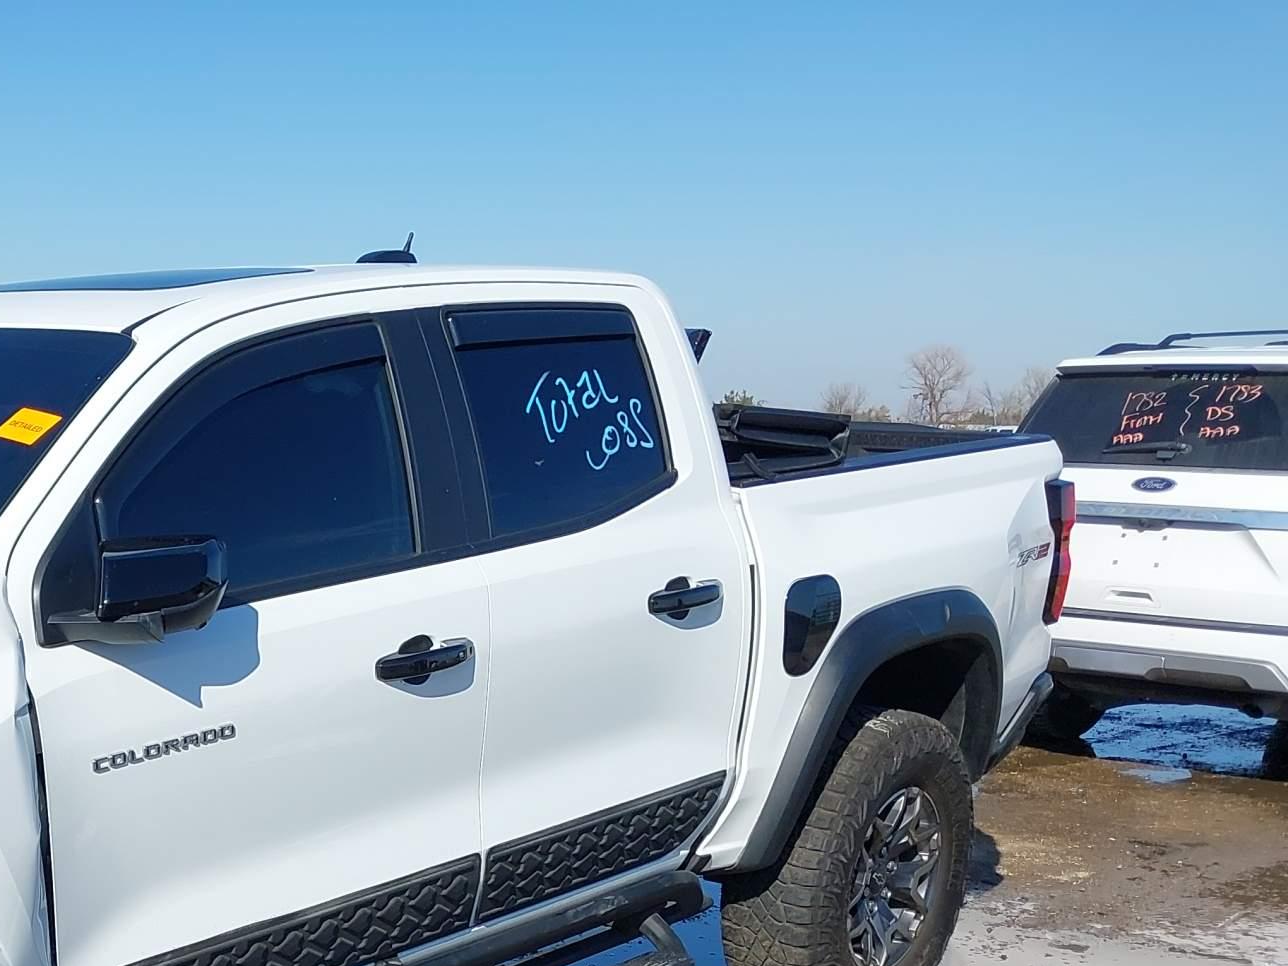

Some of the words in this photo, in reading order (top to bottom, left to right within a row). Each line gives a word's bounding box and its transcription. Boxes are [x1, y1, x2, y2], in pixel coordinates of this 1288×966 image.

[1206, 405, 1235, 421] DS
[8, 420, 44, 433] DETAILED
[1016, 542, 1051, 568] ZR2
[93, 723, 236, 774] COLORADO
